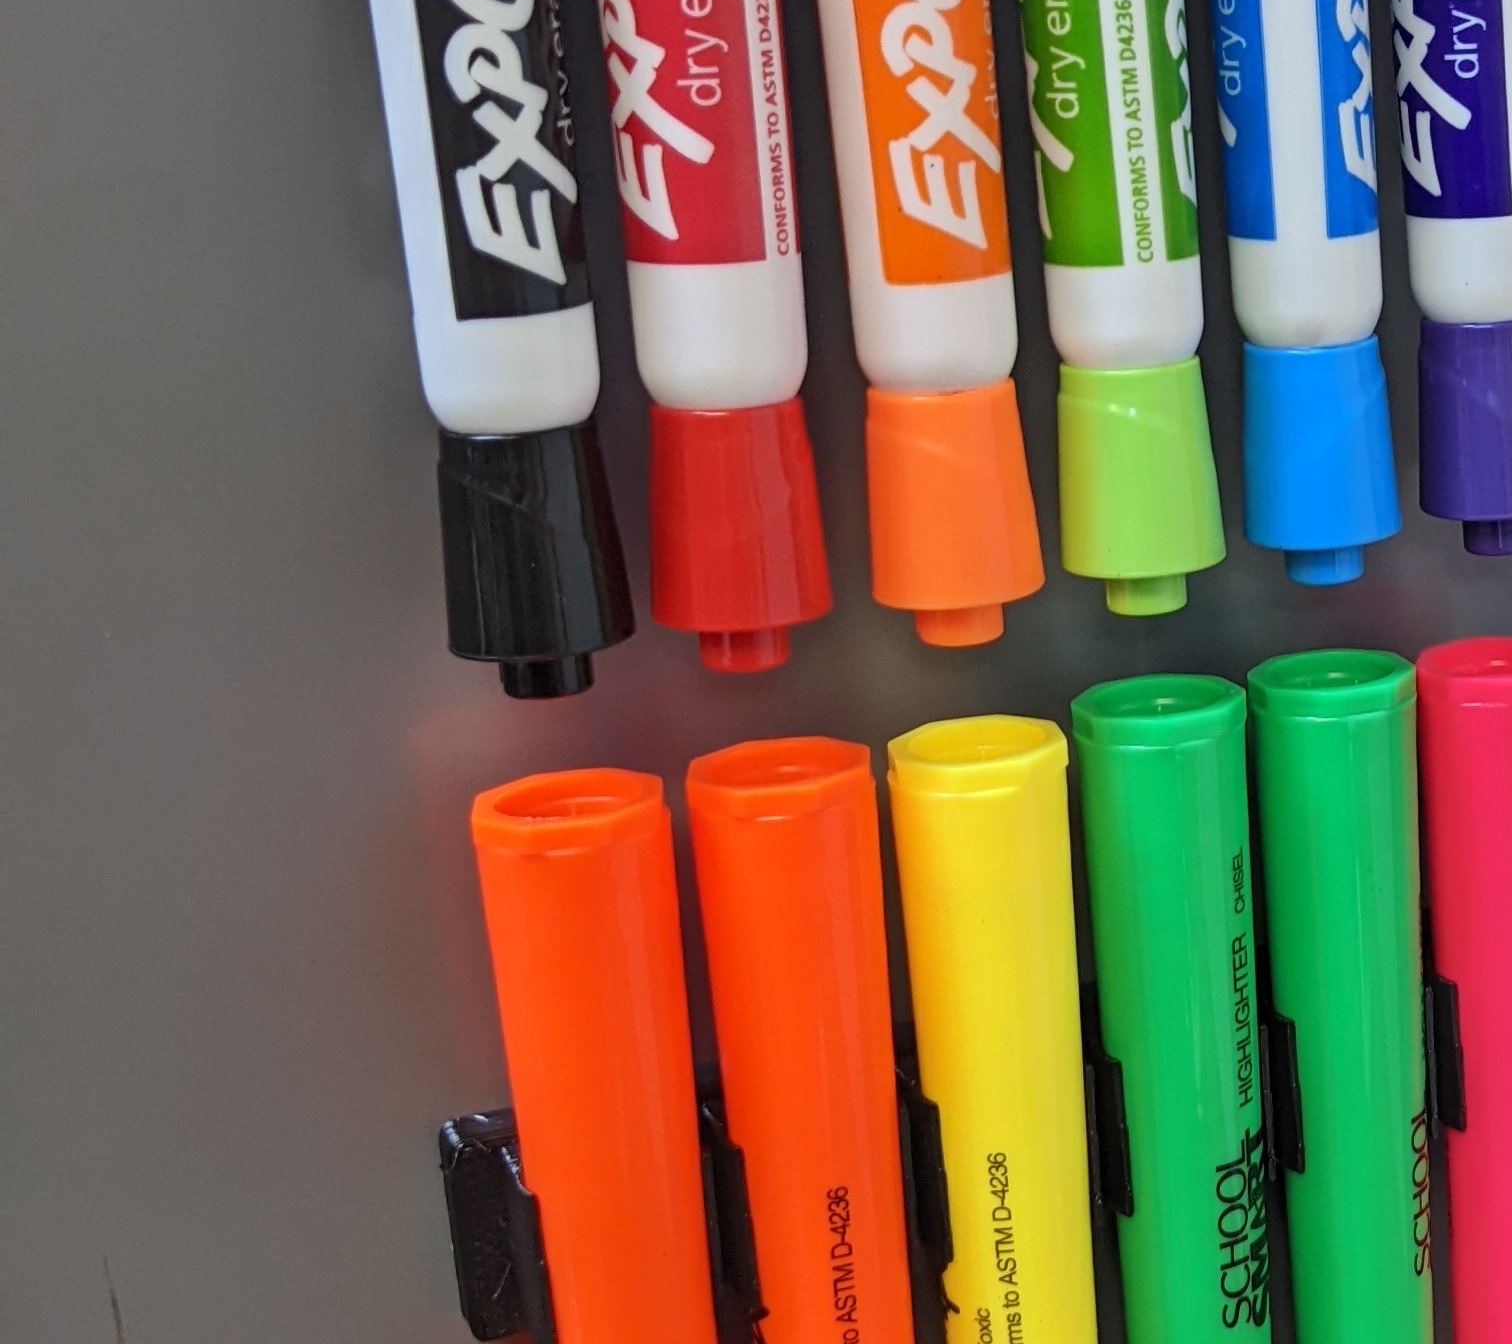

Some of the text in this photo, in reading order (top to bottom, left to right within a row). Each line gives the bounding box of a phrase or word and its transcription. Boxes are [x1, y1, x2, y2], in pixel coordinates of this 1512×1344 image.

[675, 29, 729, 107] dry
[758, 46, 778, 107] ASTM
[1220, 24, 1247, 97] dry
[1443, 10, 1487, 80] dry
[1046, 45, 1087, 120] dry
[1120, 57, 1140, 115] ASTM
[764, 111, 780, 140] TO
[1125, 118, 1143, 148] TO
[766, 141, 789, 257] CONFORMS
[1127, 145, 1154, 264] CONFORMS
[1231, 846, 1254, 1109] HIGHLIGHTER CHISEL
[987, 1152, 1013, 1222] D-4236
[826, 1185, 853, 1260] D-4236
[994, 1226, 1019, 1286] ASTM
[1215, 1138, 1253, 1329] SCHOOL
[832, 1261, 858, 1323] ASTM
[1003, 1290, 1021, 1310] to
